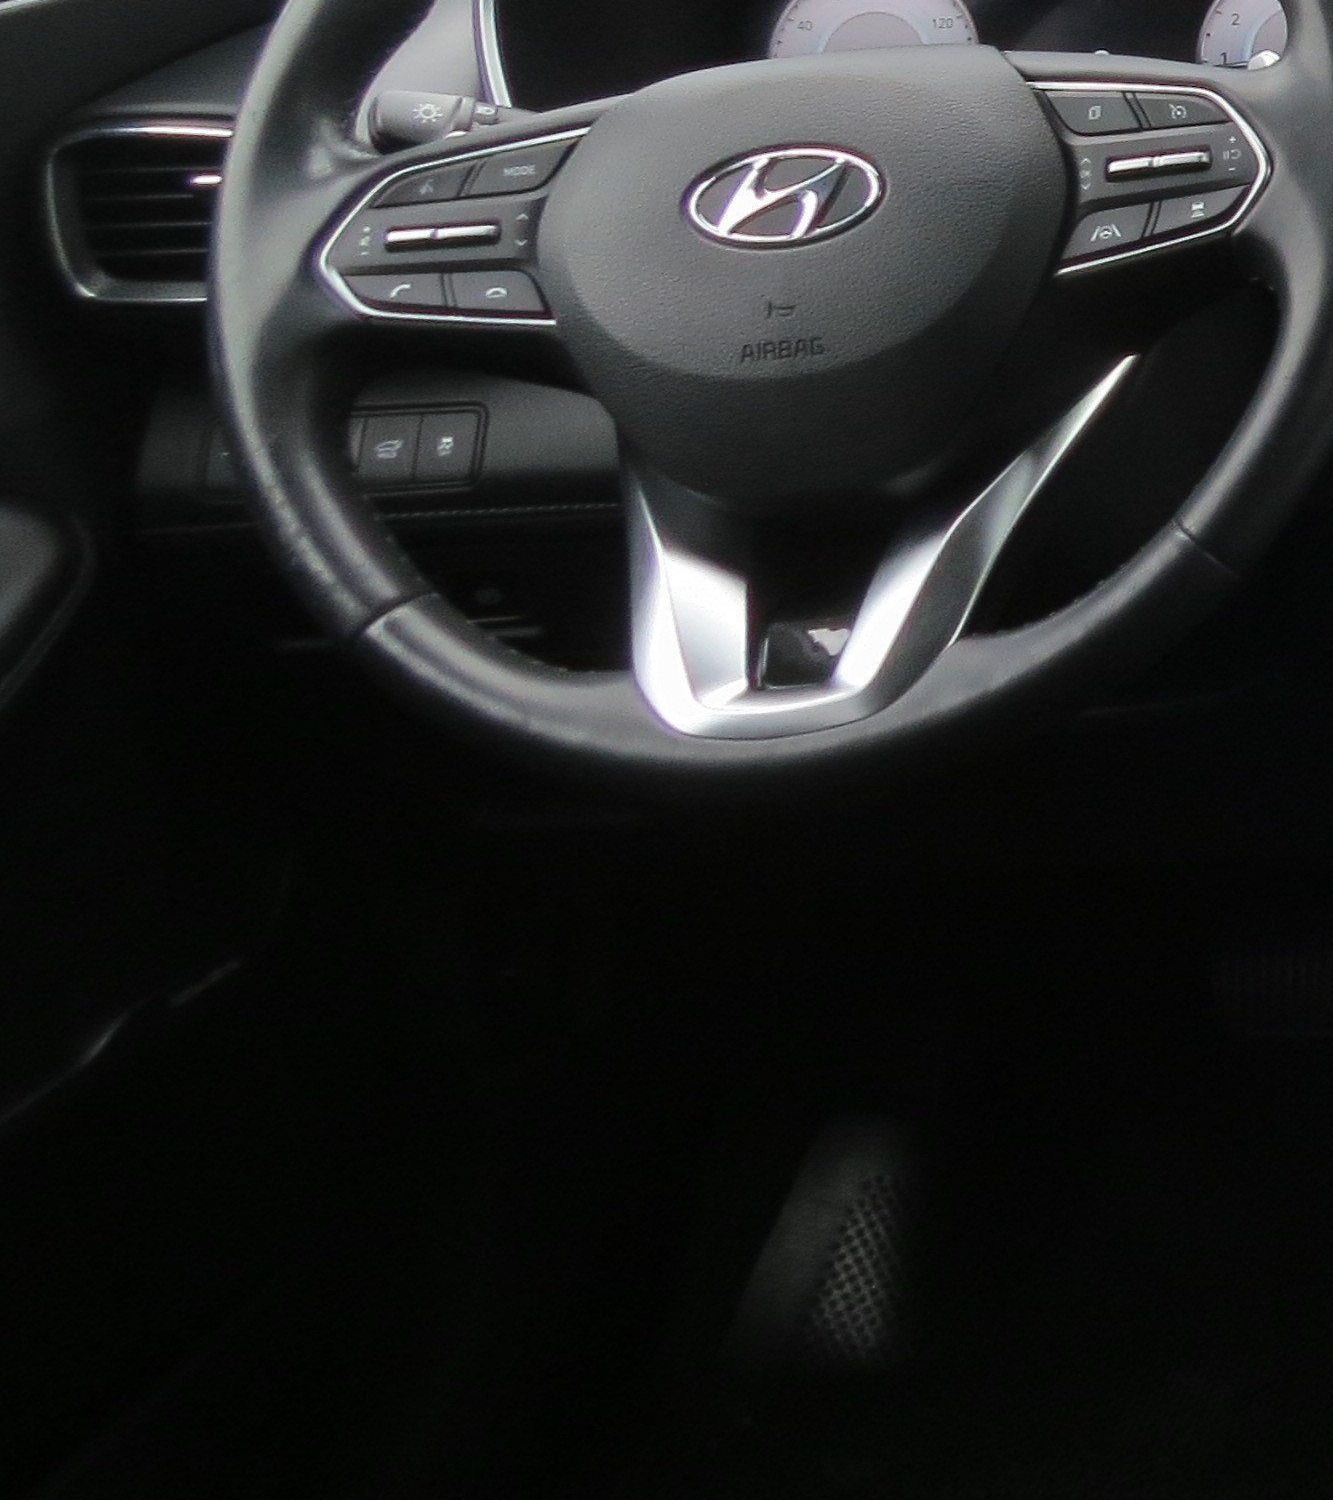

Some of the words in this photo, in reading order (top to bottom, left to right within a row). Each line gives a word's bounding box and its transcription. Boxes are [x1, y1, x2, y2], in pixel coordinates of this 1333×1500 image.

[797, 20, 813, 32] 40
[932, 17, 954, 29] 120
[1231, 13, 1240, 26] 2
[503, 164, 536, 177] MODE
[739, 336, 826, 363] AIRBAG
